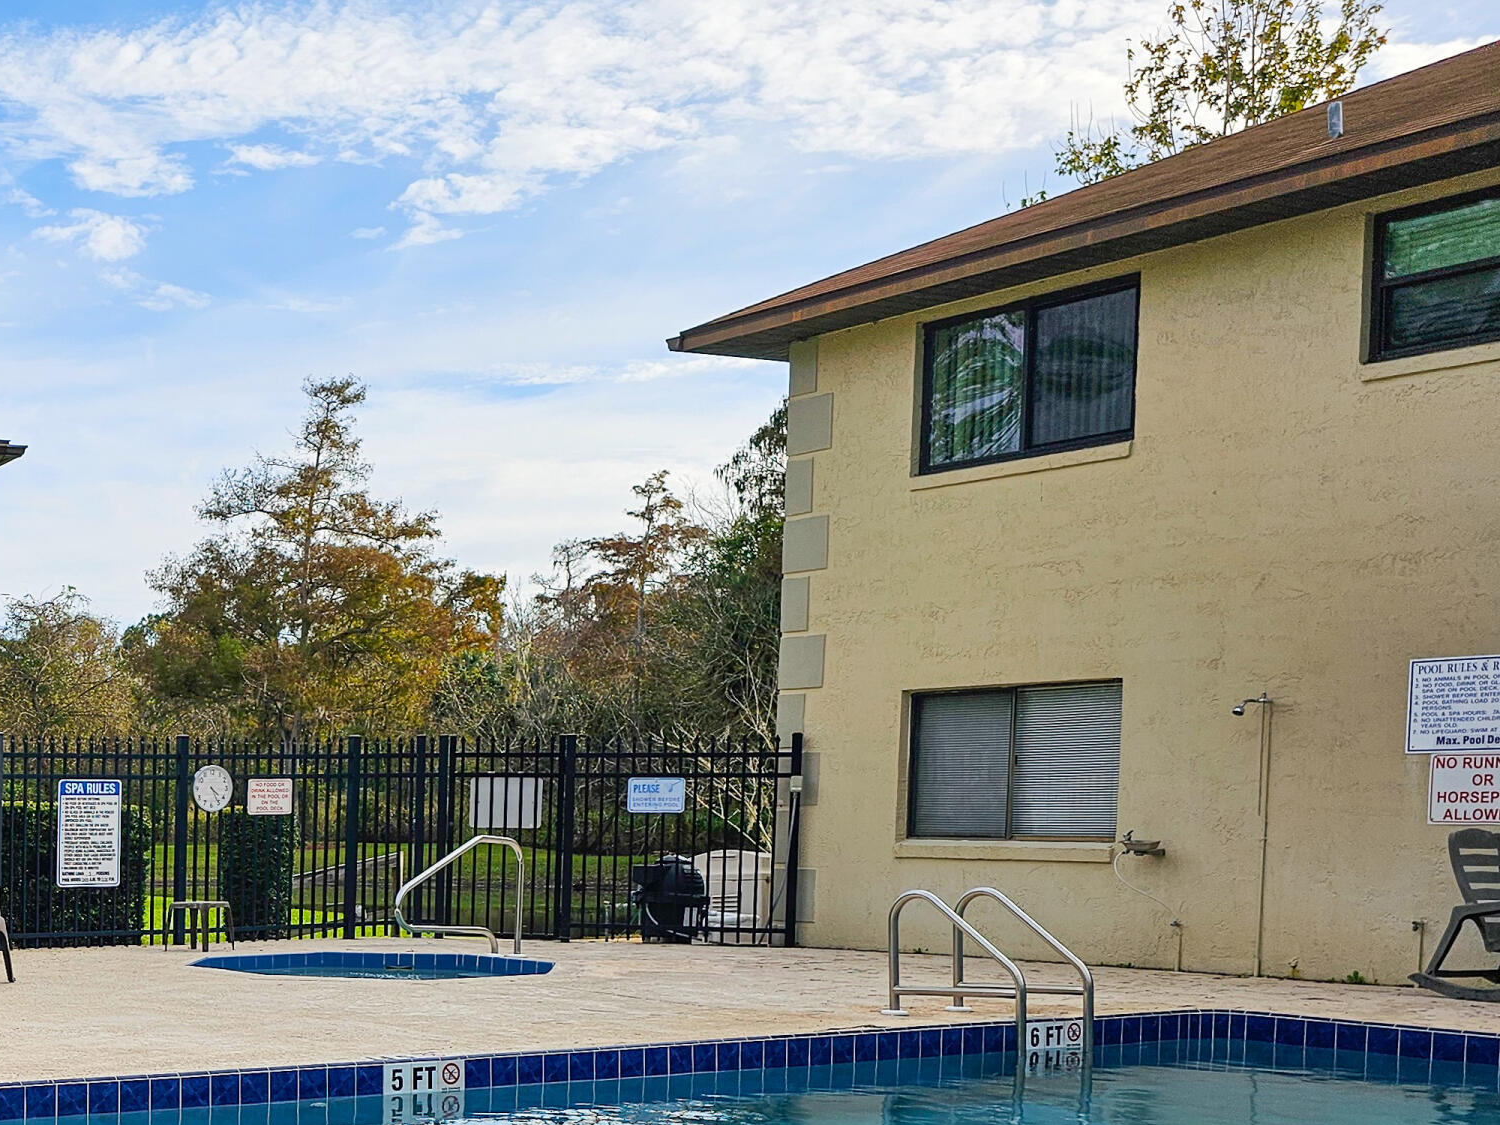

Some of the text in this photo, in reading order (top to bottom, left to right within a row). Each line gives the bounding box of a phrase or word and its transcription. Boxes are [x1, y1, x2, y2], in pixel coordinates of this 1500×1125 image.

[1418, 664, 1444, 675] POOL
[1447, 662, 1478, 673] RULES
[1481, 661, 1489, 671] &
[1436, 734, 1500, 746] Max. Pool De
[1436, 757, 1458, 769] NO
[1472, 773, 1494, 787] OR
[65, 782, 116, 794] SPA RULES
[633, 784, 661, 793] PLEASE
[1437, 790, 1500, 804] HORSEP
[1443, 808, 1500, 821] ALLOW
[1030, 1025, 1064, 1048] 6 FT
[391, 1066, 437, 1091] 5 FT
